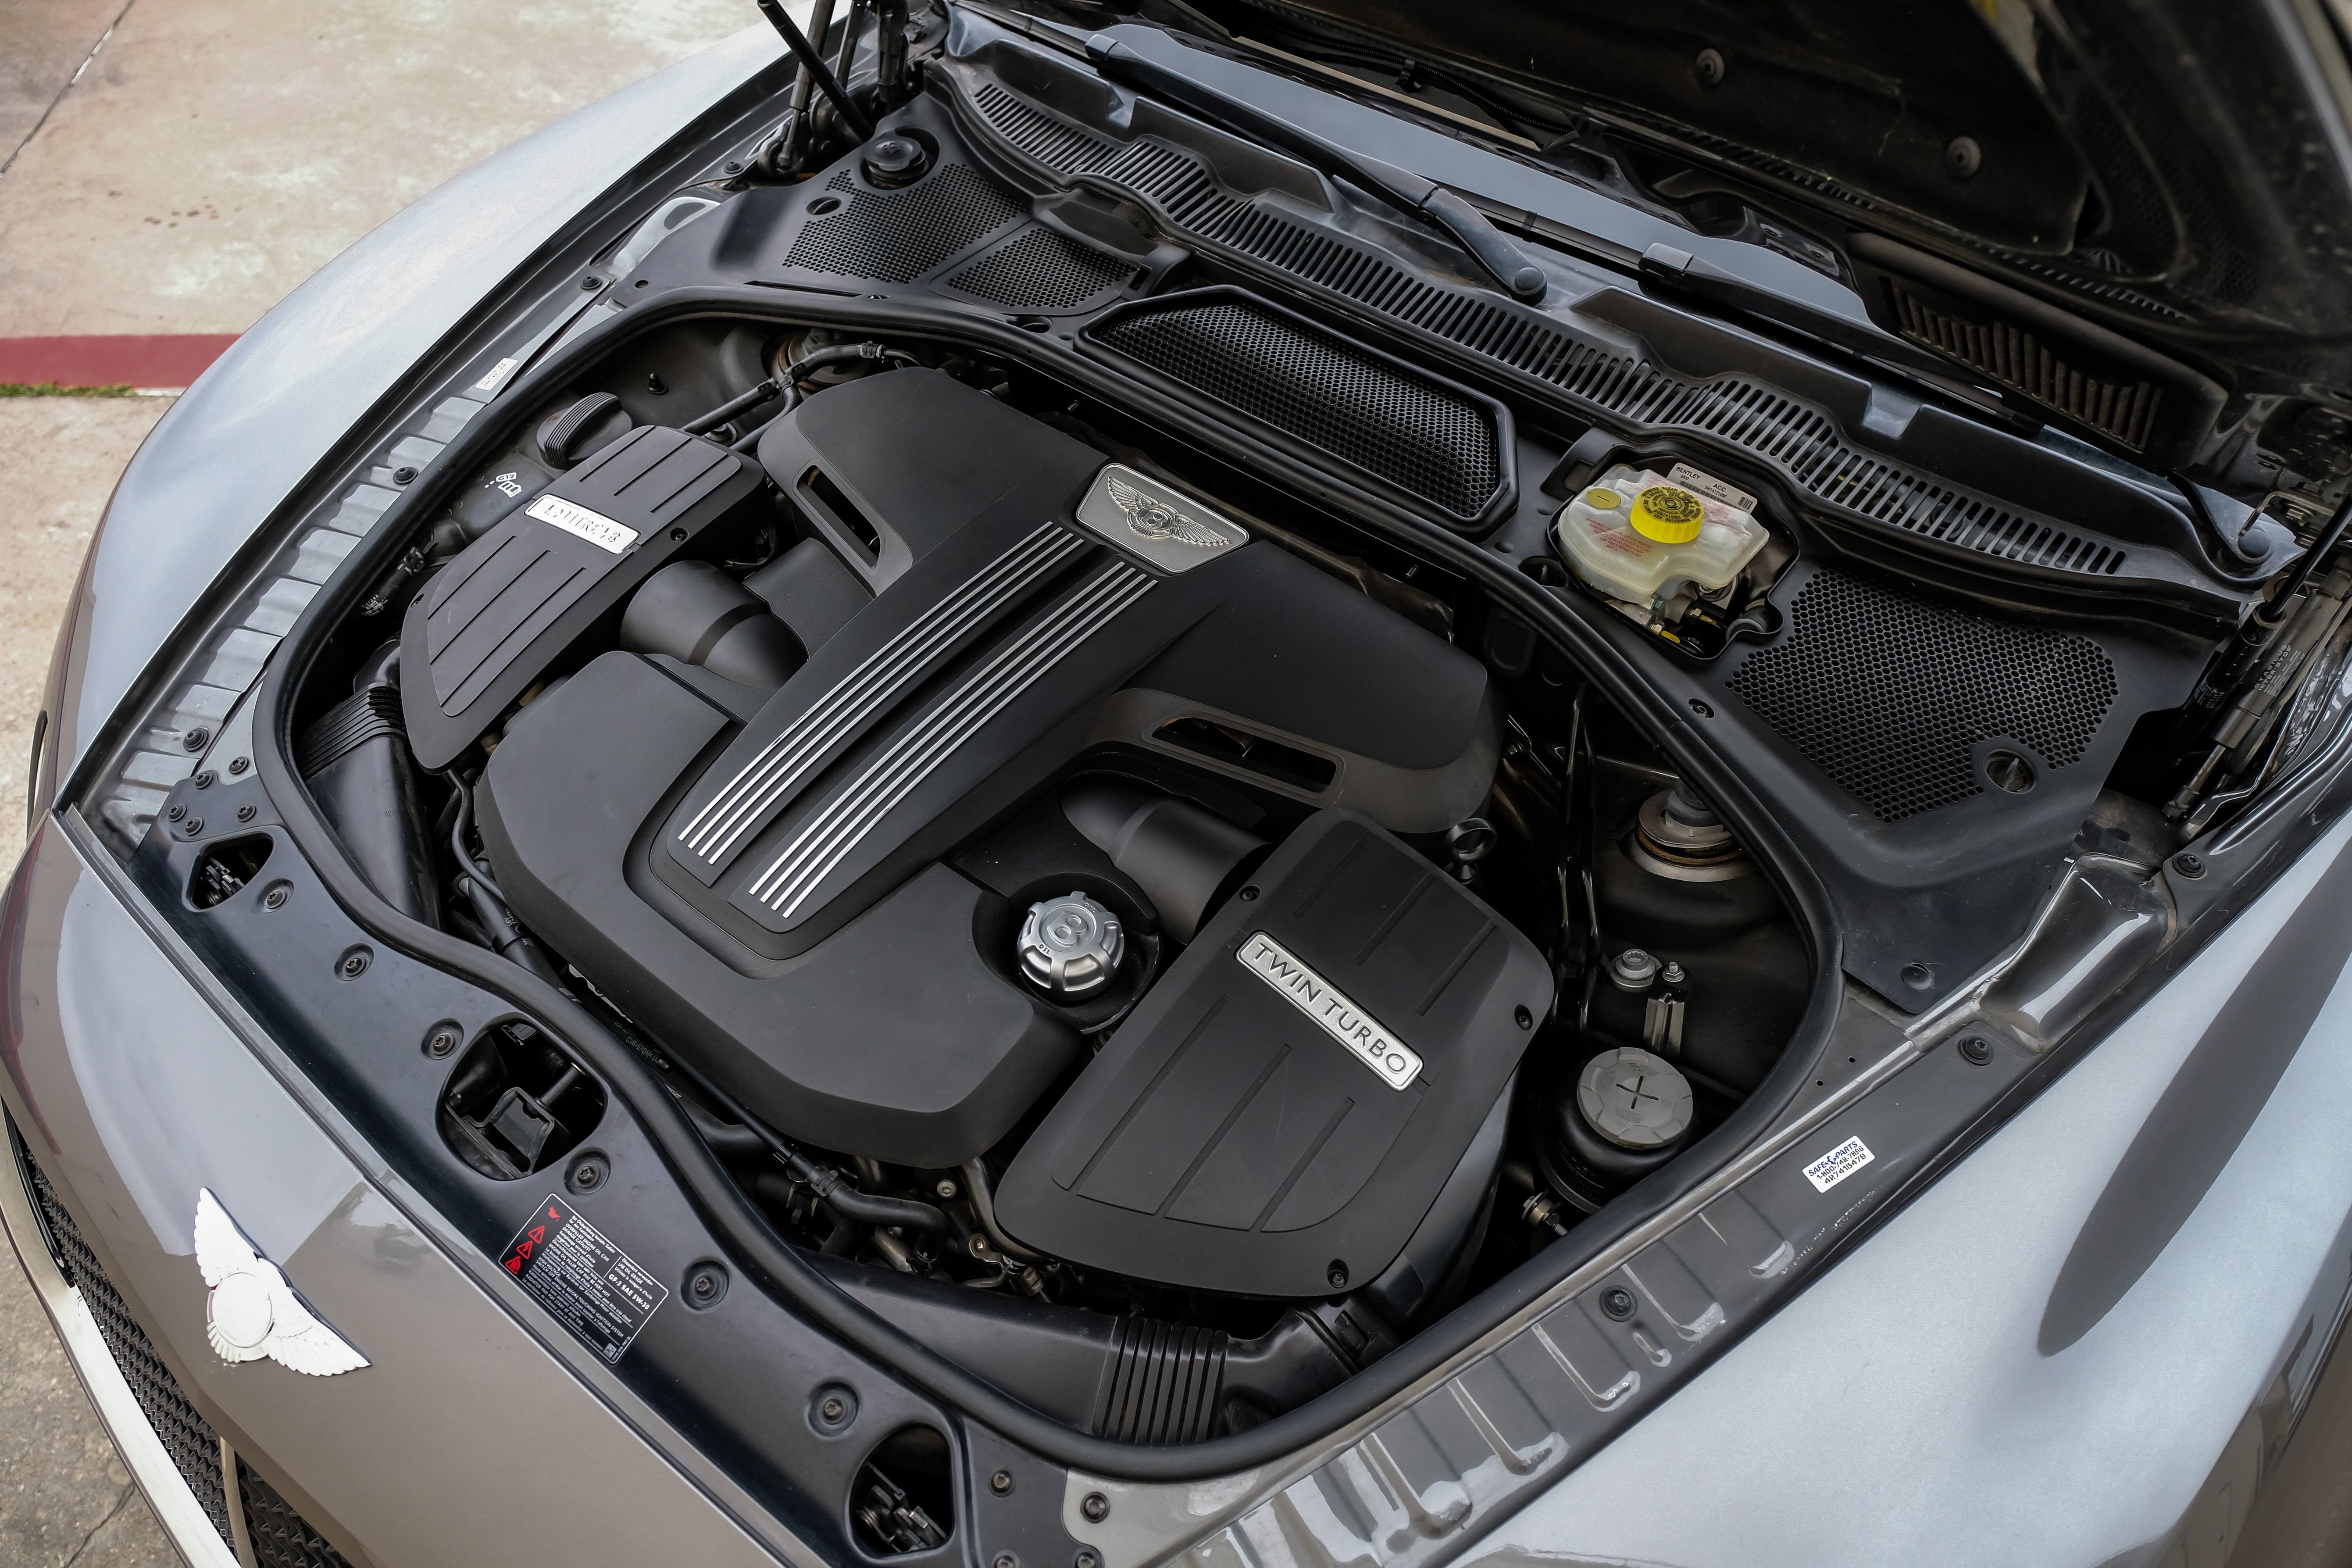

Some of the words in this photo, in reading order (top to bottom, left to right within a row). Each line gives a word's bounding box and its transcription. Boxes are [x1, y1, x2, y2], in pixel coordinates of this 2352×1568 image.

[1676, 466, 1701, 480] BENTLEY
[1713, 483, 1727, 492] ACC
[1039, 944, 1052, 955] OIL
[1253, 942, 1323, 1005] TWIN
[1324, 997, 1406, 1075] TURBO
[1809, 1161, 1827, 1176] SAFE
[1835, 1142, 1857, 1158] PARTS
[621, 1285, 633, 1296] SAE
